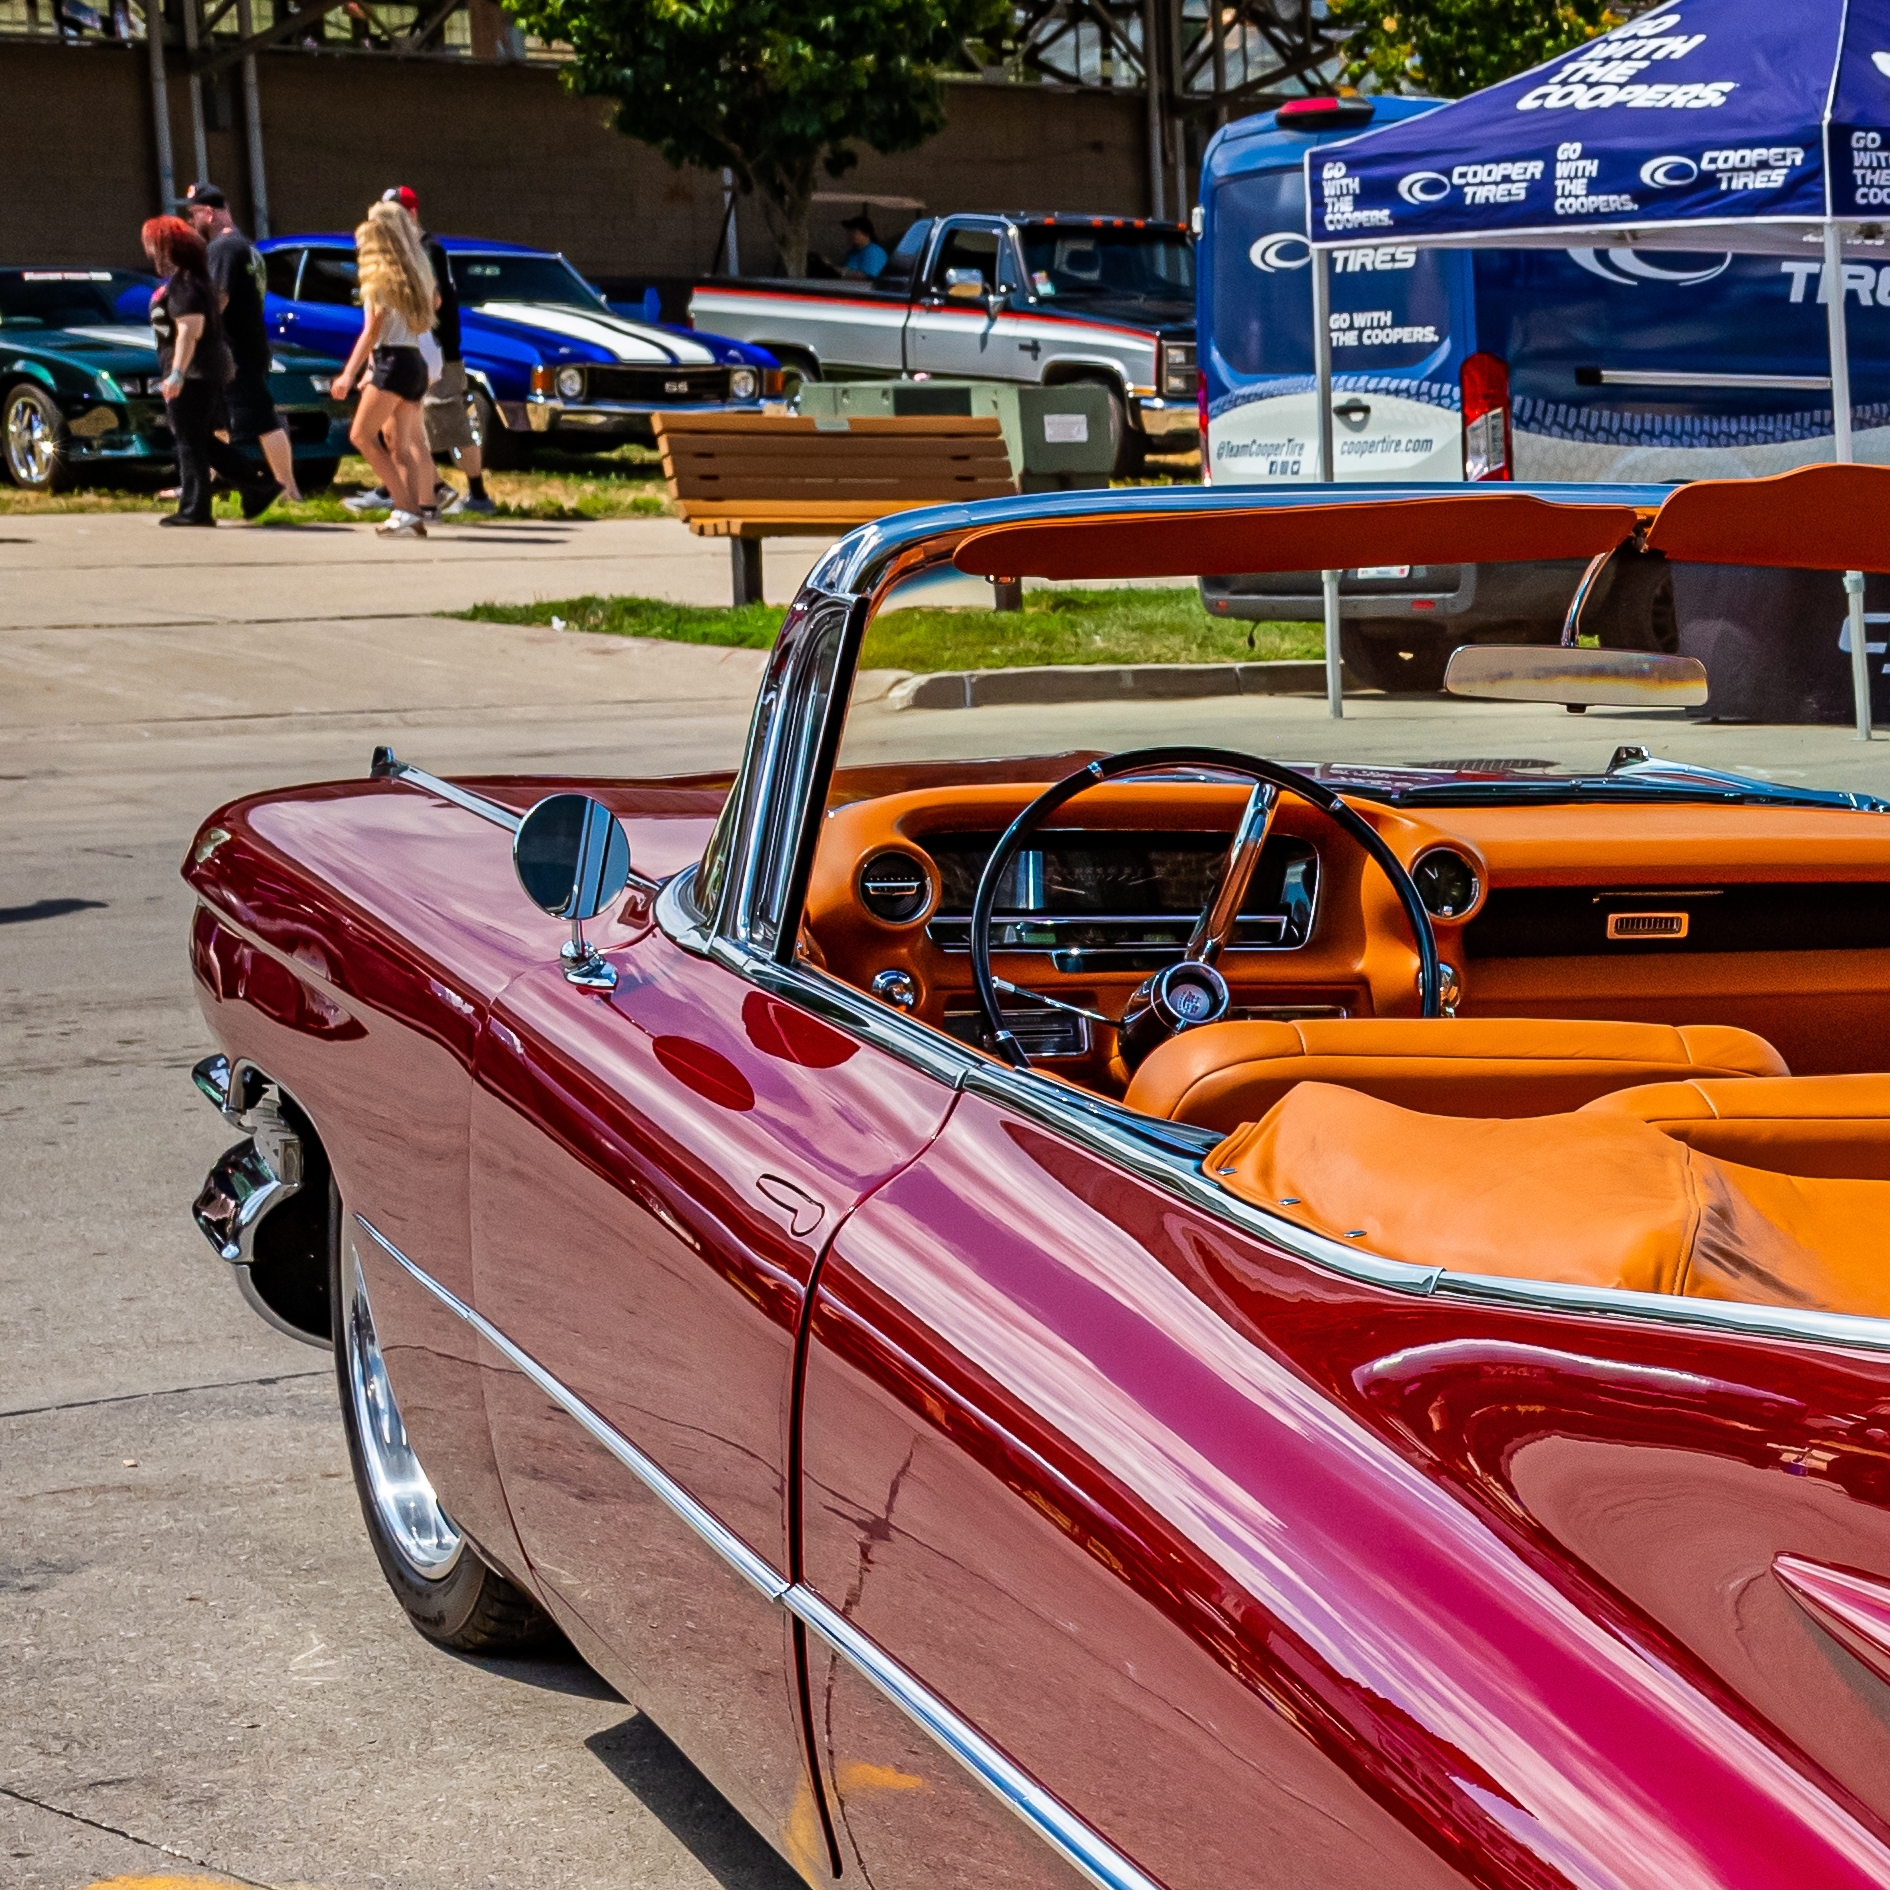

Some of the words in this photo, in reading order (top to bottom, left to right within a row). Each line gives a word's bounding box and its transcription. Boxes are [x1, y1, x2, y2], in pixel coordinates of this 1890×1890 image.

[1607, 14, 1682, 41] GO
[1579, 34, 1707, 60] WITH
[1548, 60, 1651, 83] THE
[1852, 132, 1881, 149] GO
[1557, 142, 1582, 160] GO
[1700, 148, 1804, 171] COOPER
[1322, 162, 1346, 179] GO
[1452, 160, 1544, 185] COOPER
[1556, 159, 1599, 178] WITH
[1323, 177, 1360, 195] WITH
[1555, 178, 1587, 196] THE
[1716, 168, 1788, 190] TIRES
[1463, 181, 1529, 205] TIRES
[1325, 195, 1354, 212] THE
[1332, 247, 1417, 273] TIRES
[1329, 314, 1350, 329] GO
[1353, 311, 1392, 327] WITH
[1330, 331, 1358, 347] THE
[1340, 436, 1433, 458] coopertire.com
